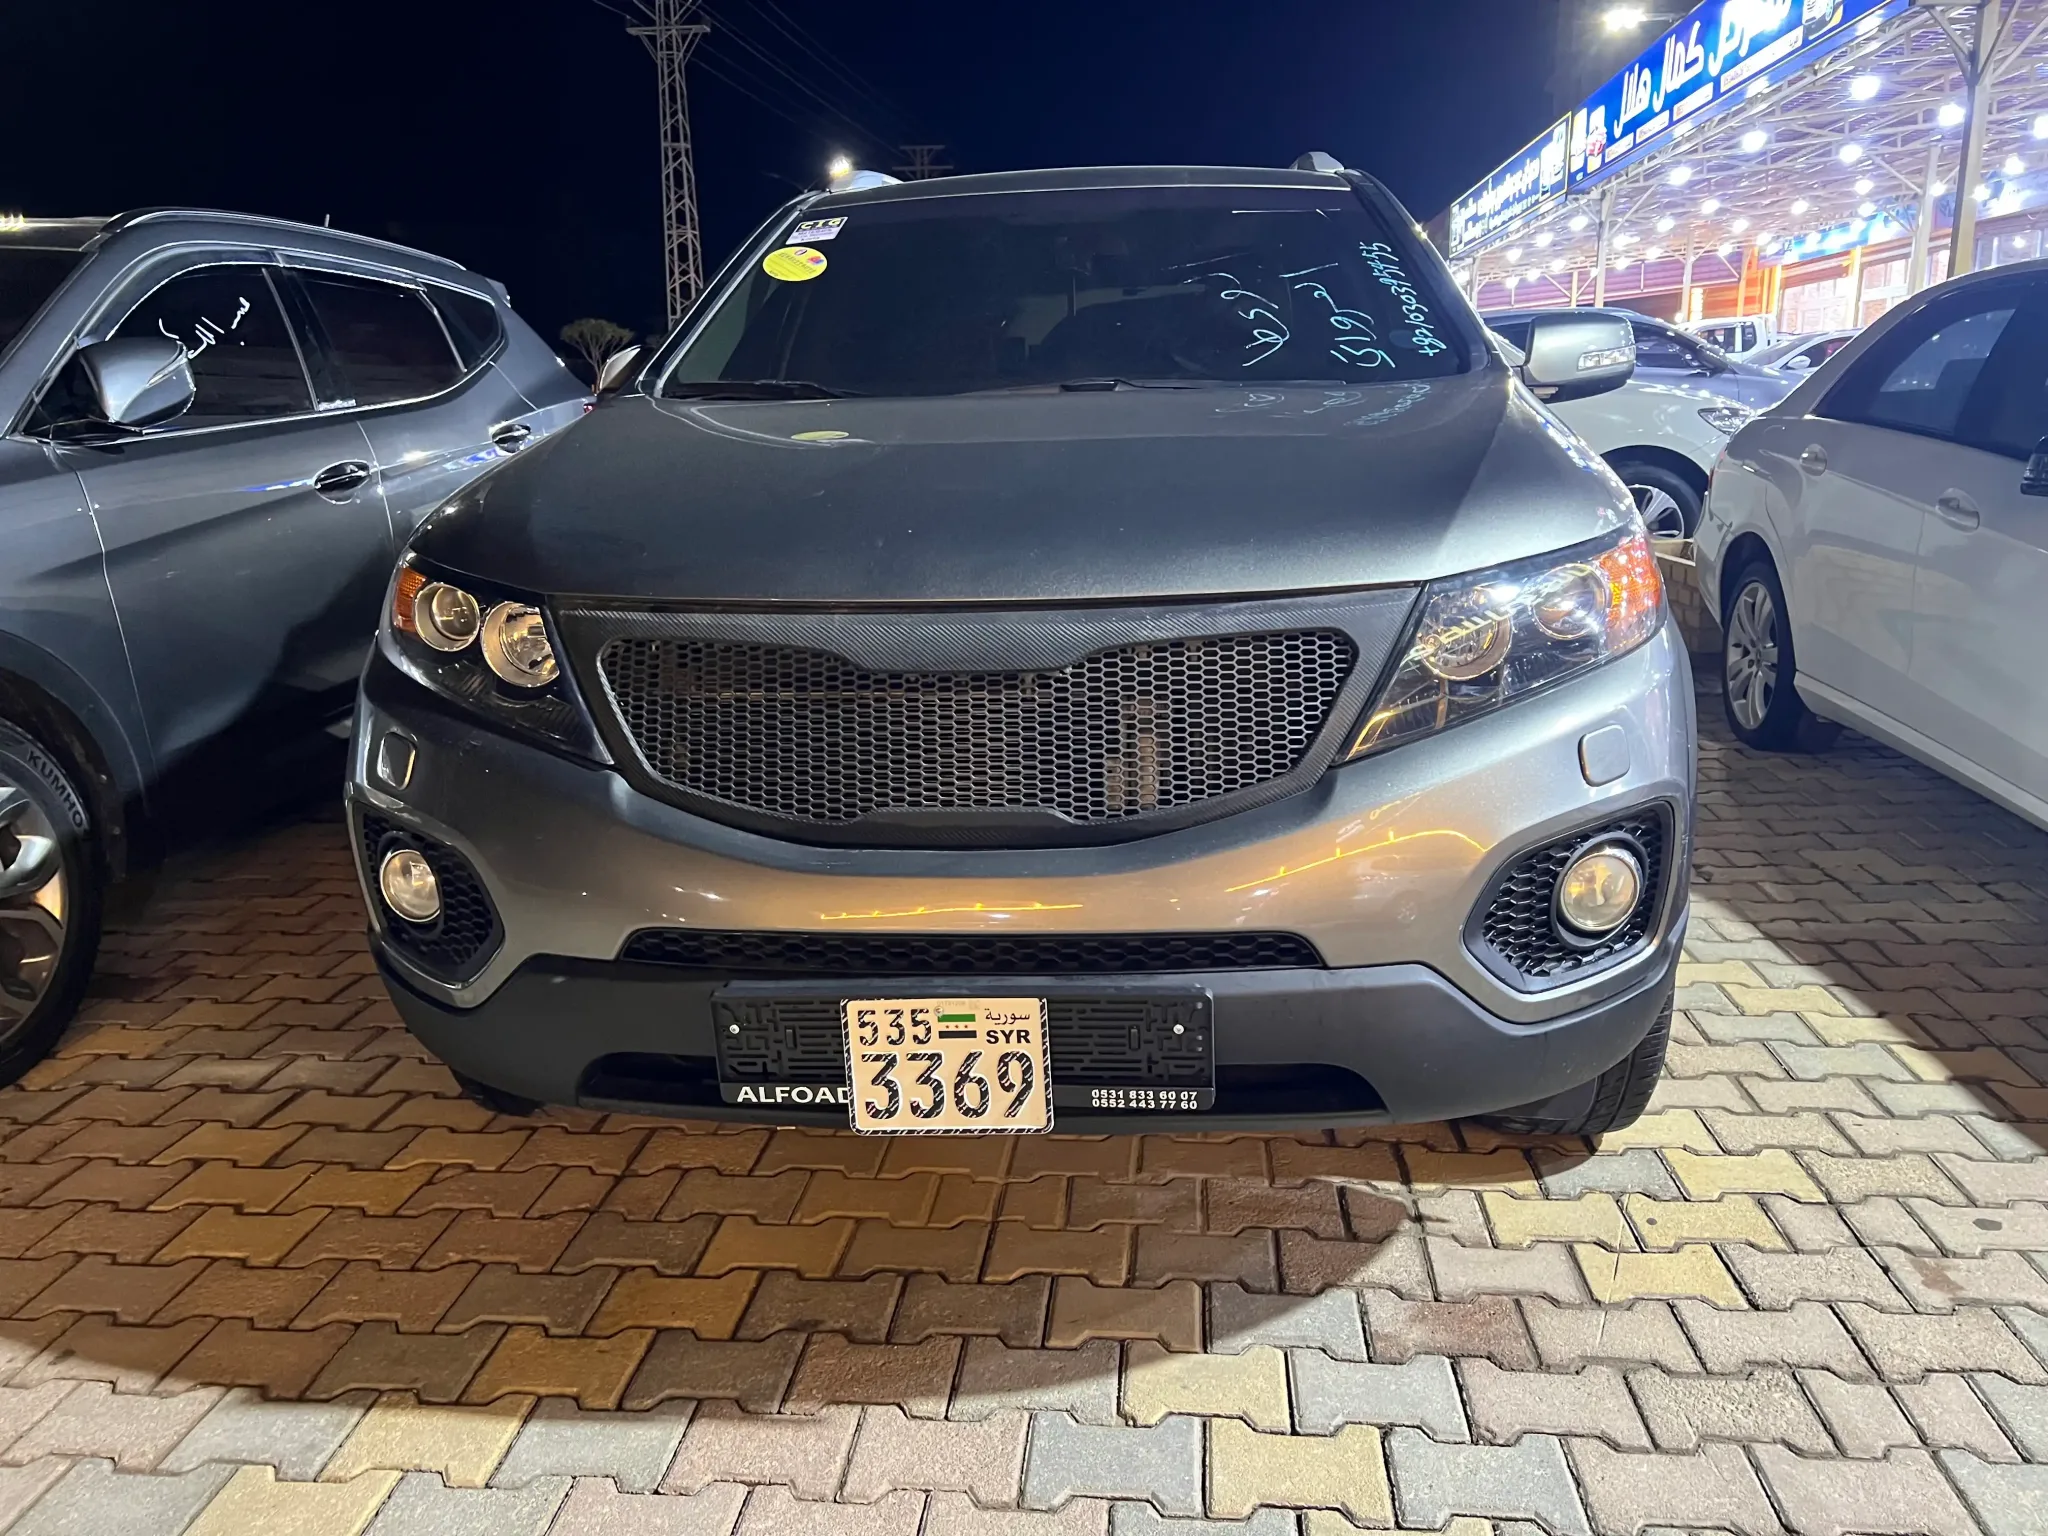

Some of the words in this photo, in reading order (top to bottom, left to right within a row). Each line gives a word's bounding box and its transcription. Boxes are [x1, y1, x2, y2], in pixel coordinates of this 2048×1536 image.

[1652, 20, 1704, 113] كمال
[1613, 62, 1651, 139] هلال
[27, 749, 84, 829] KUMHO
[857, 1008, 932, 1047] 535
[984, 1007, 1031, 1026] سورية
[985, 1029, 1032, 1045] SYR
[861, 1050, 1035, 1120] 3369
[1091, 1089, 1124, 1099] 0531
[1129, 1090, 1154, 1100] 833
[1159, 1091, 1177, 1101] 60
[1180, 1091, 1198, 1101] 07
[1092, 1099, 1126, 1108] 0552
[1129, 1100, 1156, 1109] 443
[1160, 1100, 1177, 1110] 77
[1180, 1101, 1198, 1110] 60
